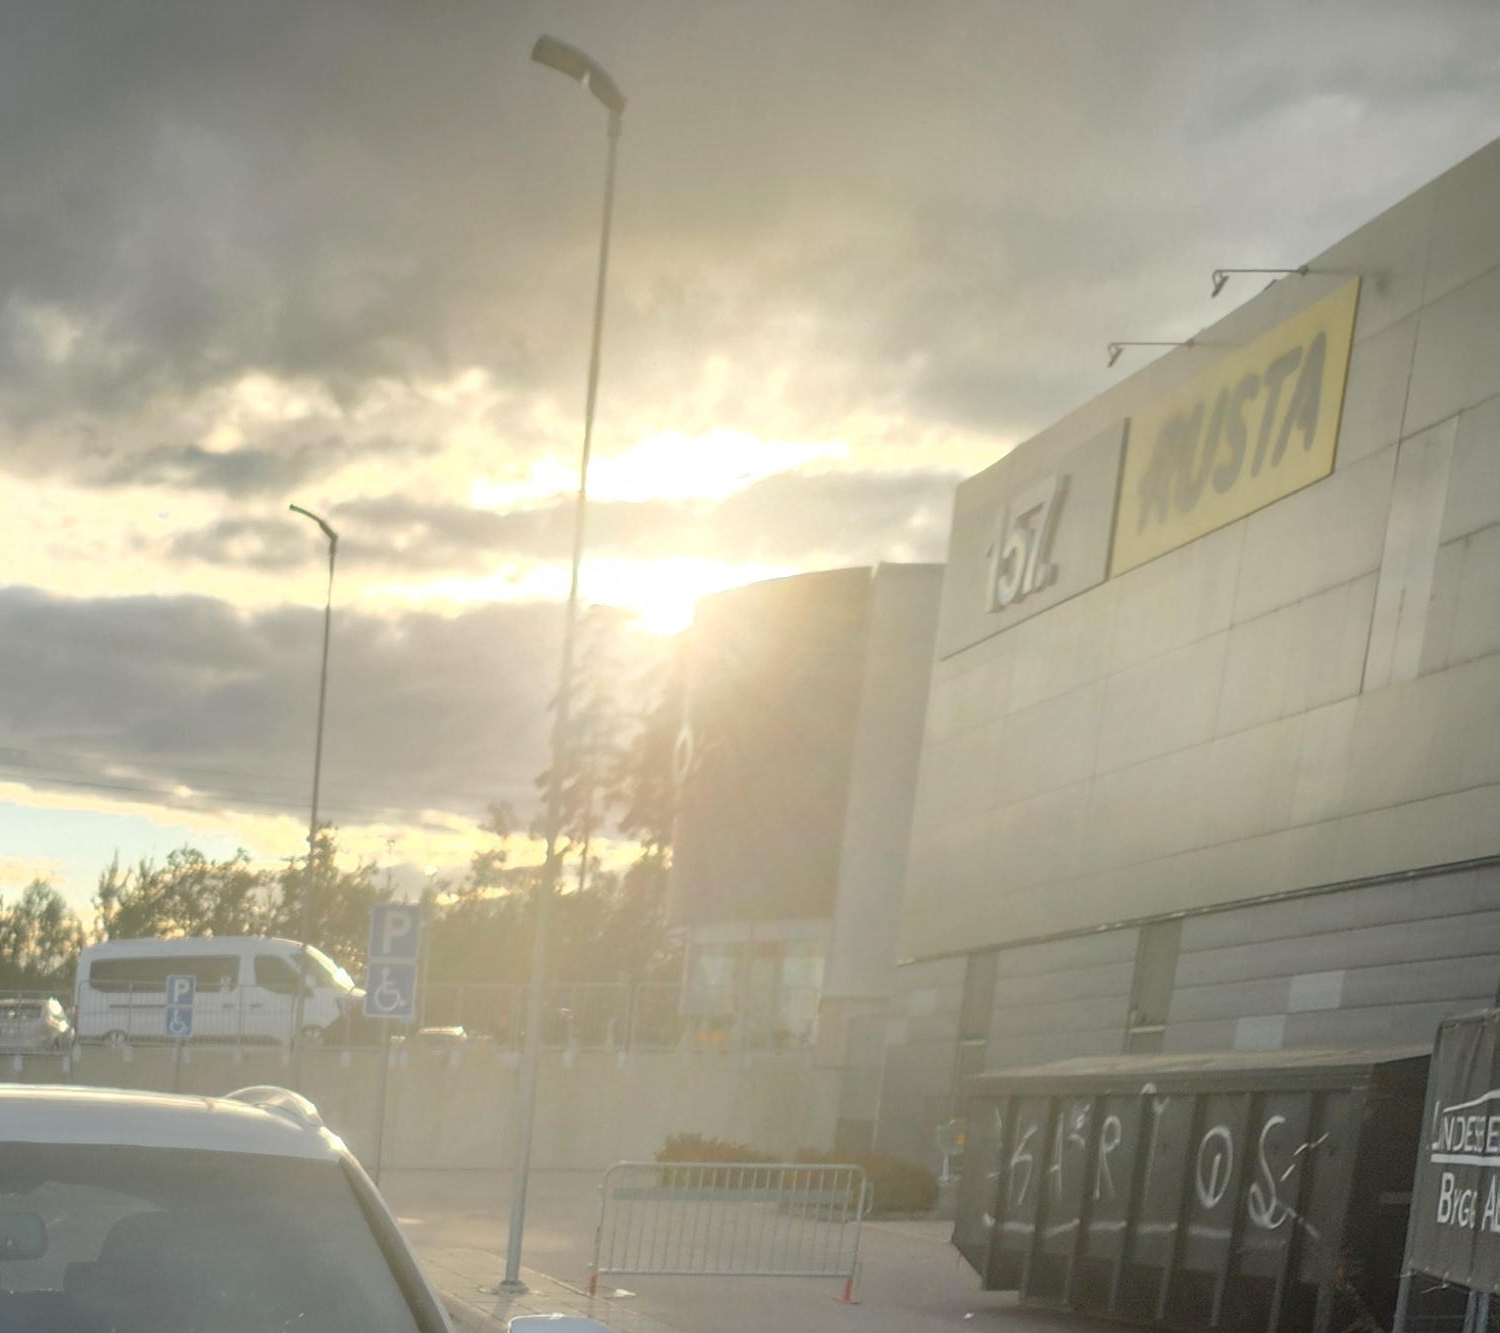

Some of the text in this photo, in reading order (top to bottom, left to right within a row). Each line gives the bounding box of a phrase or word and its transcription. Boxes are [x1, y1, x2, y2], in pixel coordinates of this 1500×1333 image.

[1136, 331, 1327, 536] RUSTA
[383, 911, 412, 953] P
[174, 978, 190, 1002] P
